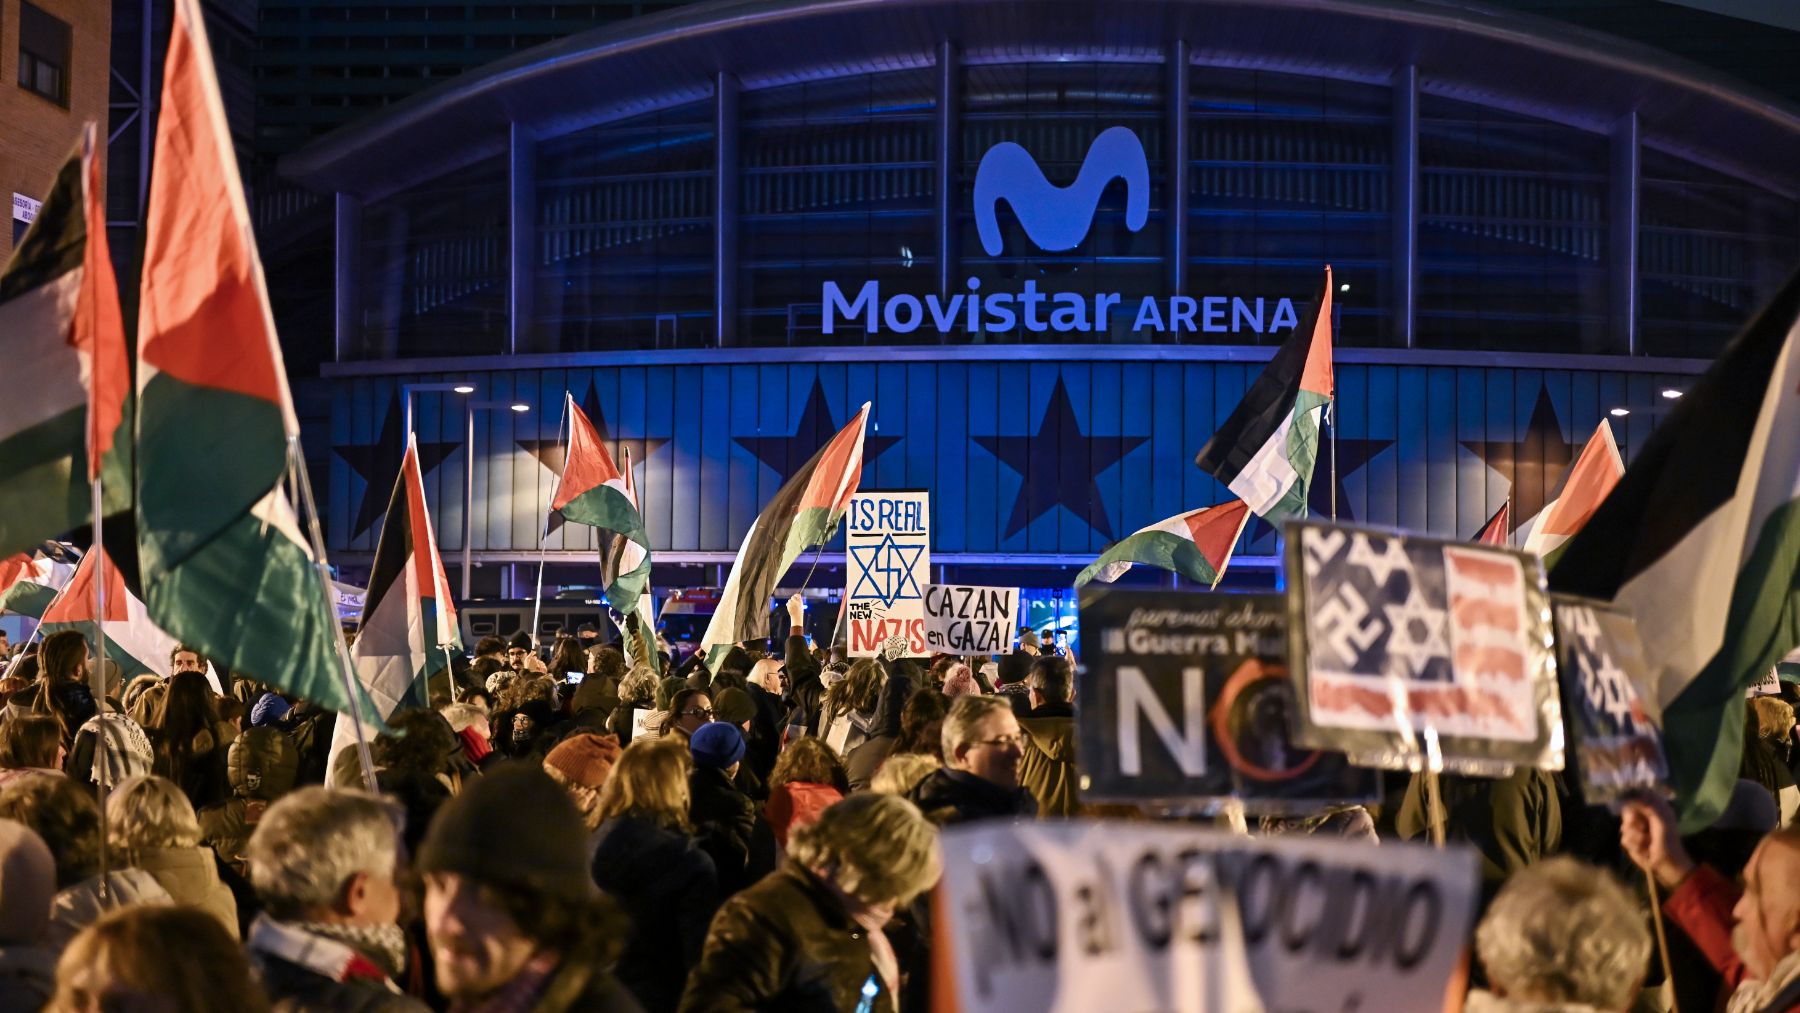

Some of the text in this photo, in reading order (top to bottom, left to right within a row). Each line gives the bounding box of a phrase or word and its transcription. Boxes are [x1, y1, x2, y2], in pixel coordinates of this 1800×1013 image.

[821, 276, 1298, 334] Movistar ARENA
[850, 602, 871, 611] THE
[850, 611, 873, 620] NEW
[925, 586, 1010, 619] CAZAN
[927, 621, 1010, 653] en GAZA!
[1127, 628, 1231, 655] Guerra
[1128, 847, 1445, 976] GENOCIDIO
